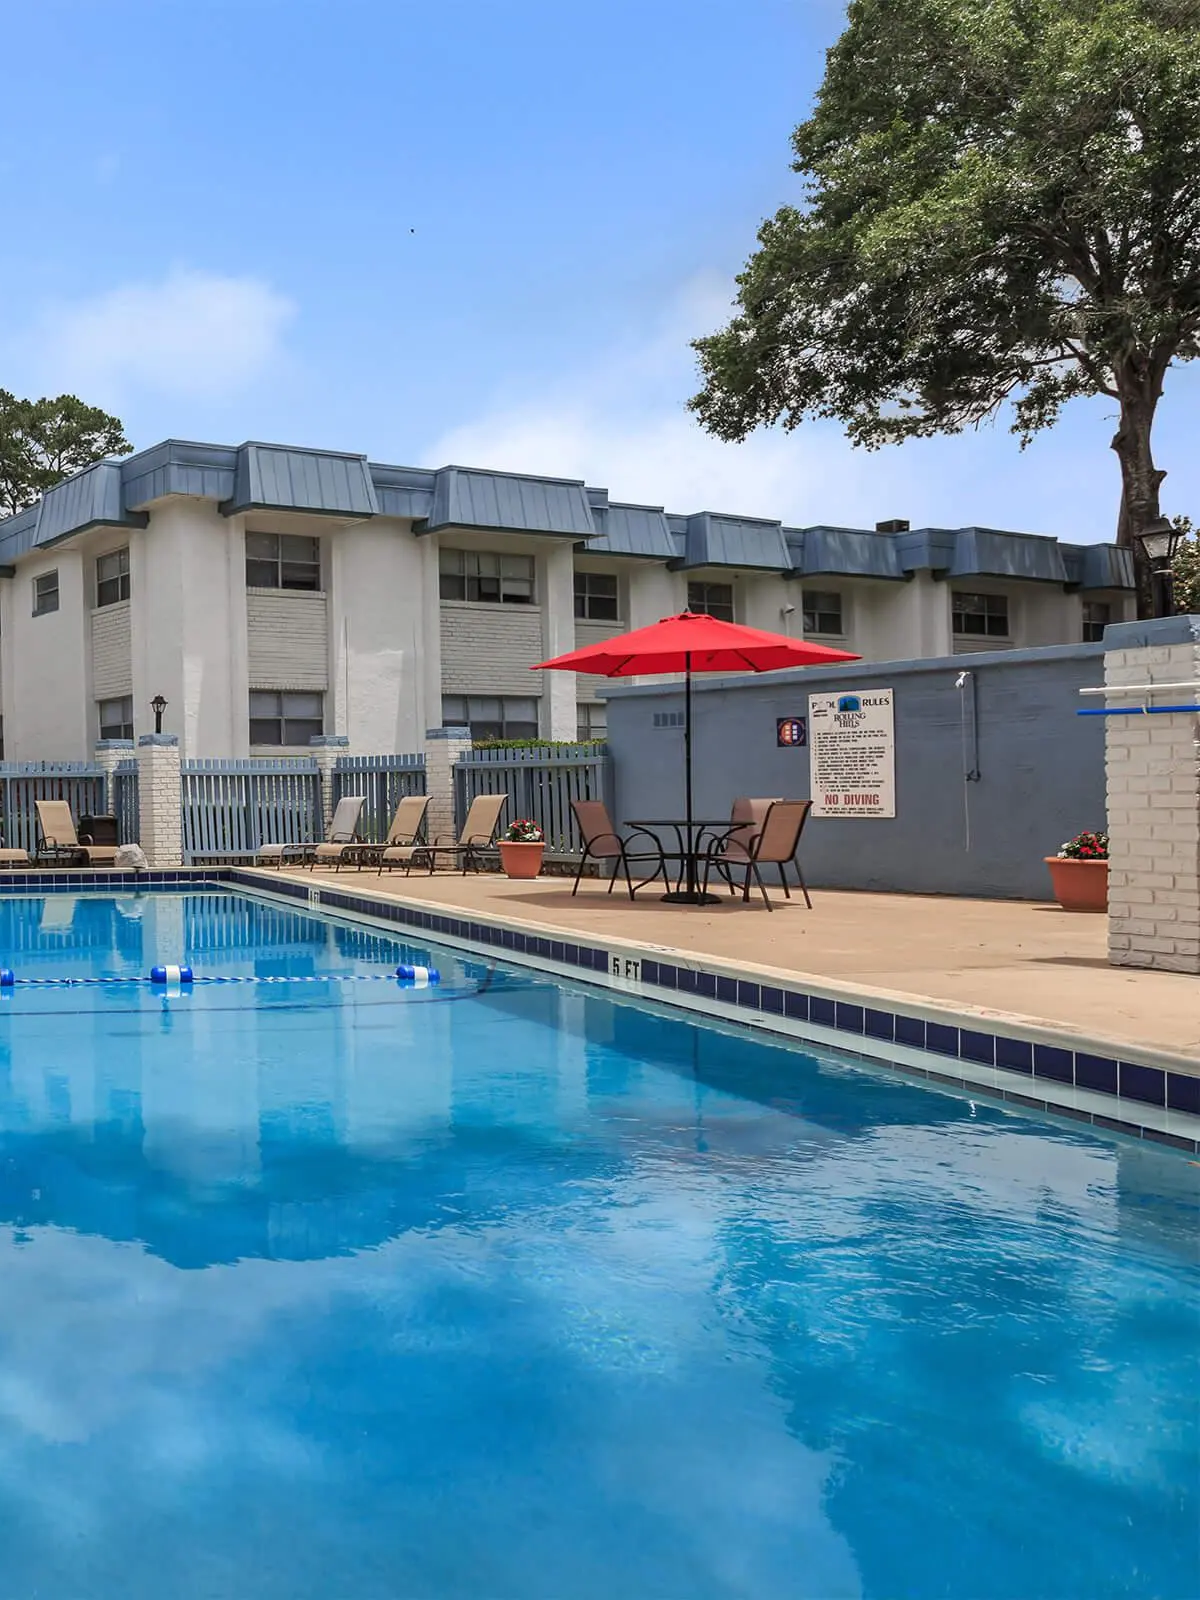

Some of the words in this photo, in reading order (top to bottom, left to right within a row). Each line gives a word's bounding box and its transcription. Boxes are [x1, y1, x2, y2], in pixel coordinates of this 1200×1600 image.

[811, 701, 836, 709] POL
[862, 698, 890, 706] RULES
[833, 712, 866, 721] ROLLING
[839, 720, 860, 728] HILLS
[824, 794, 838, 805] NO
[844, 794, 880, 805] DIVING
[613, 957, 620, 976] 5
[626, 960, 640, 980] FT
